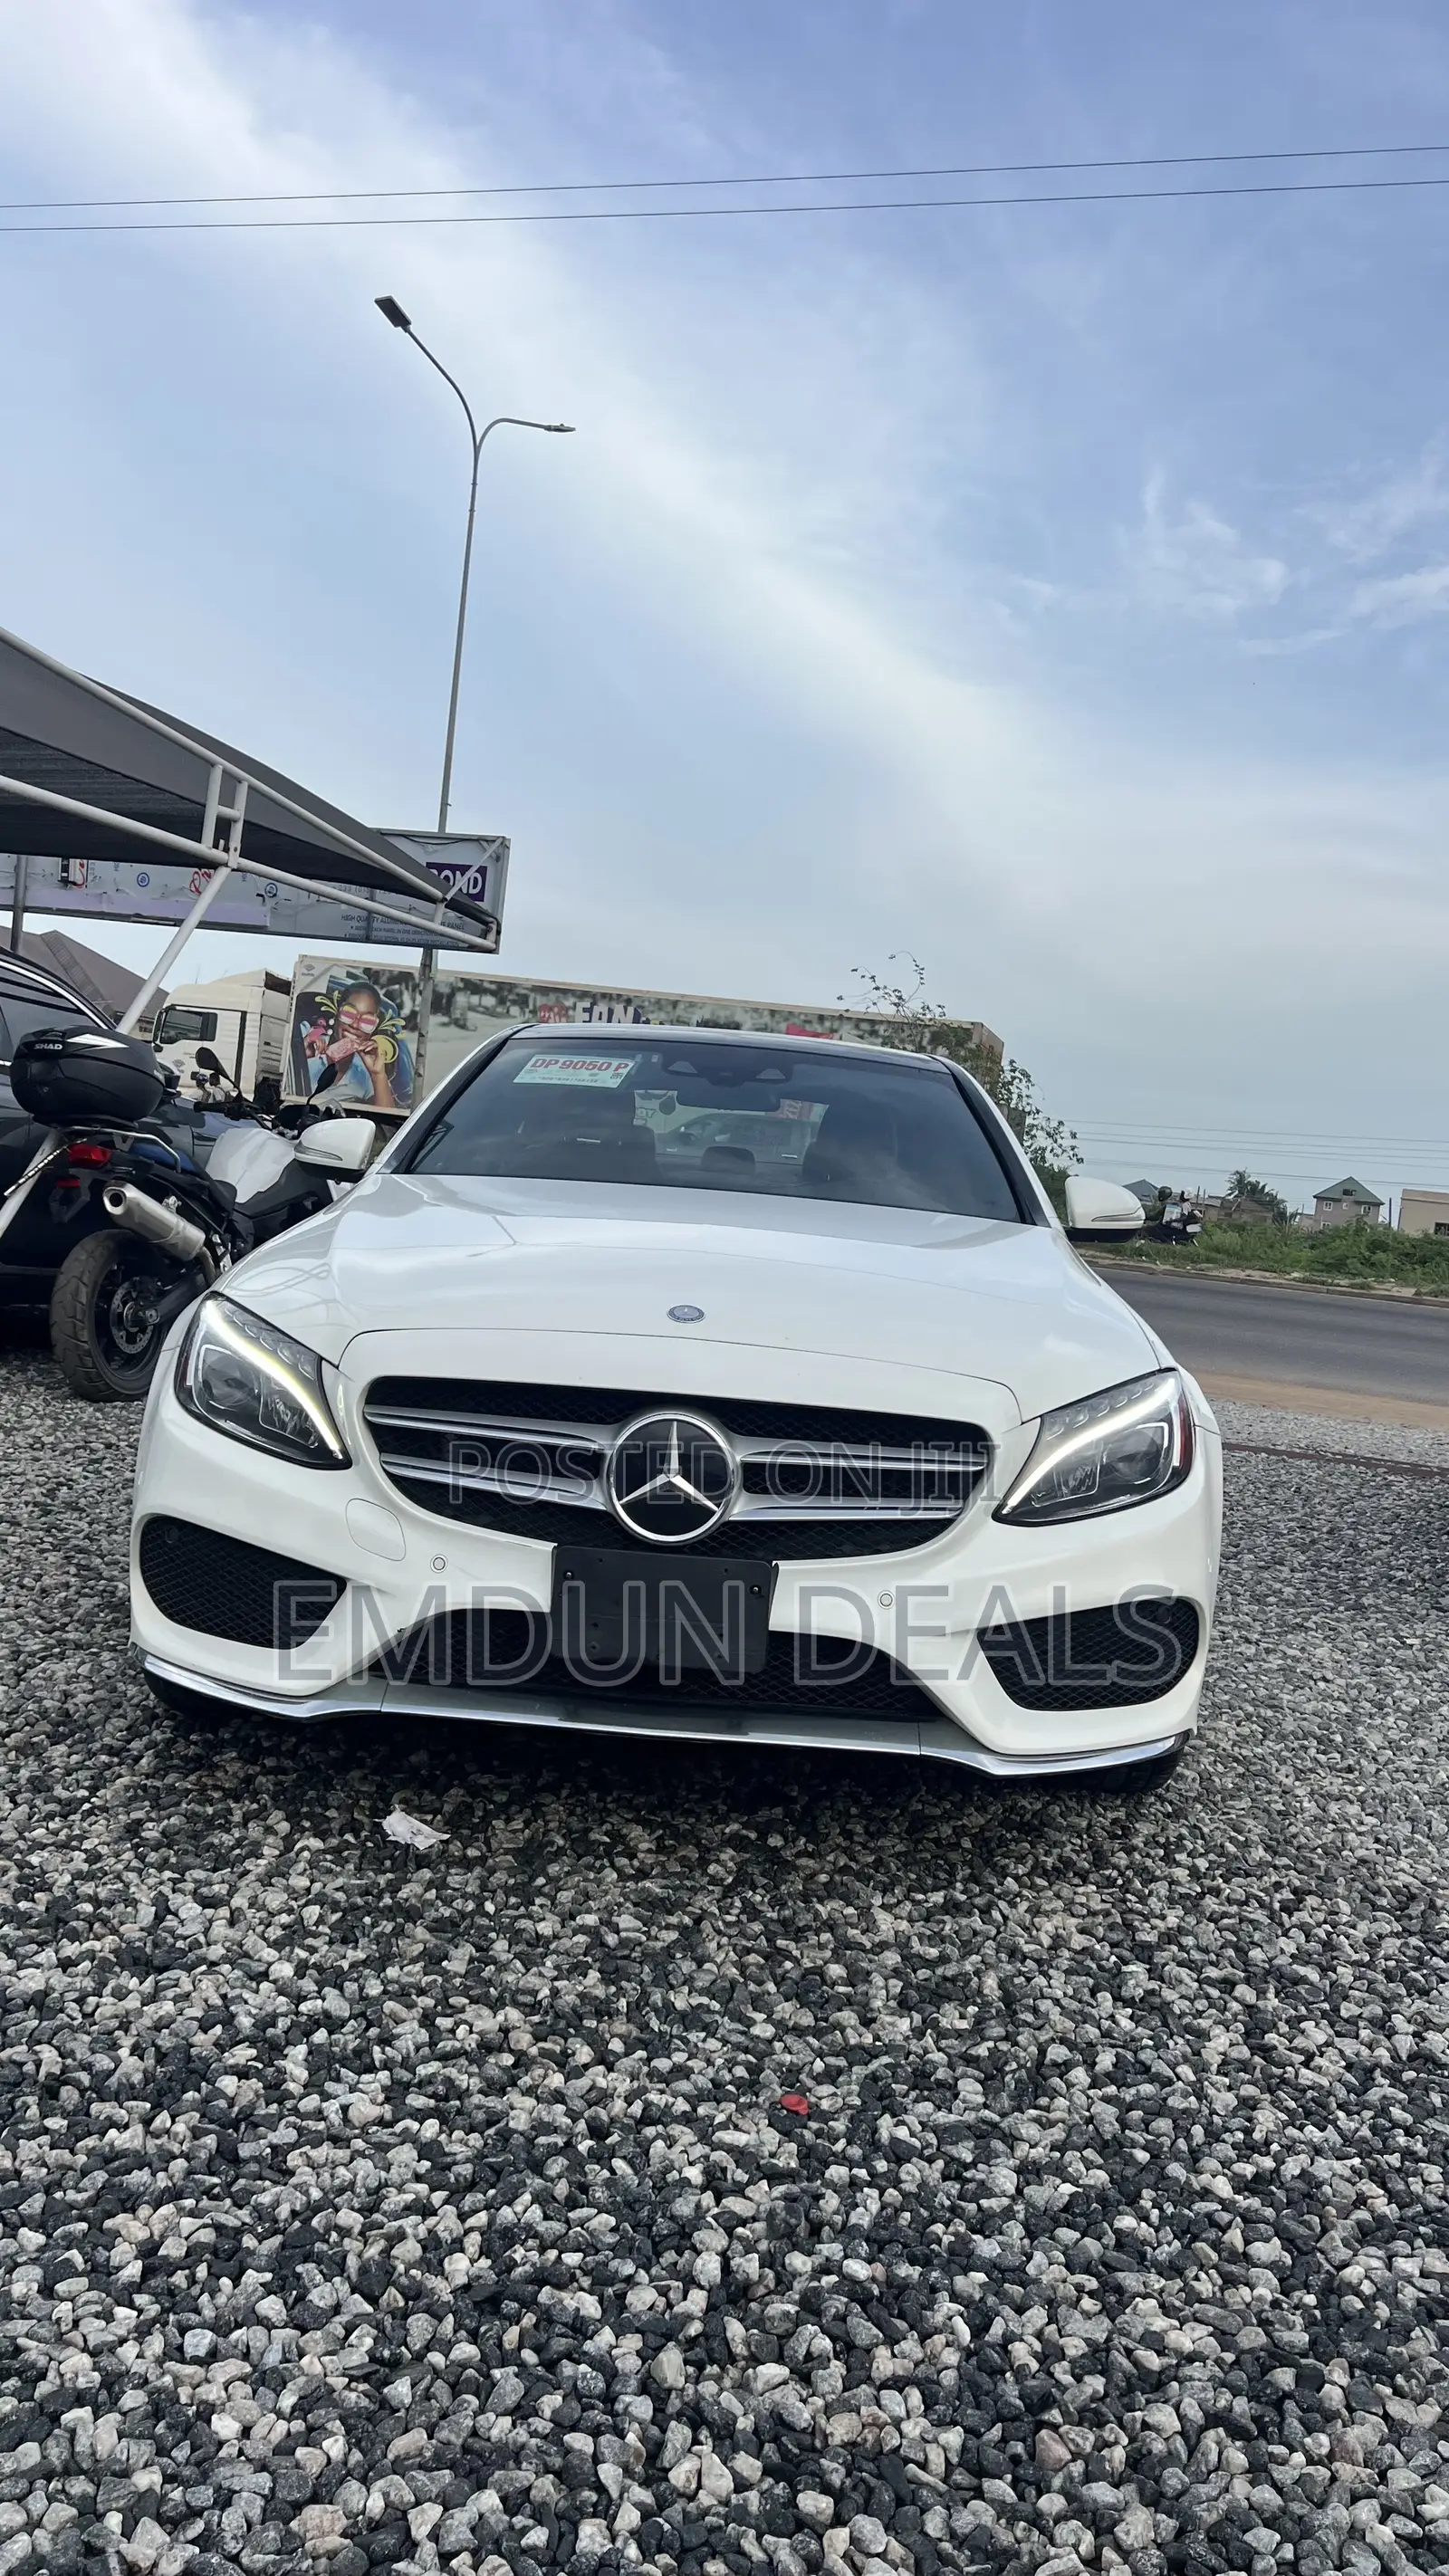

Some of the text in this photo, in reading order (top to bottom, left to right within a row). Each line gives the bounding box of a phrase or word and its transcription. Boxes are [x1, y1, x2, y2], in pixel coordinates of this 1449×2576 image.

[430, 867, 483, 895] OND
[356, 915, 380, 924] QUATY
[532, 1058, 629, 1071] DP 9050 P
